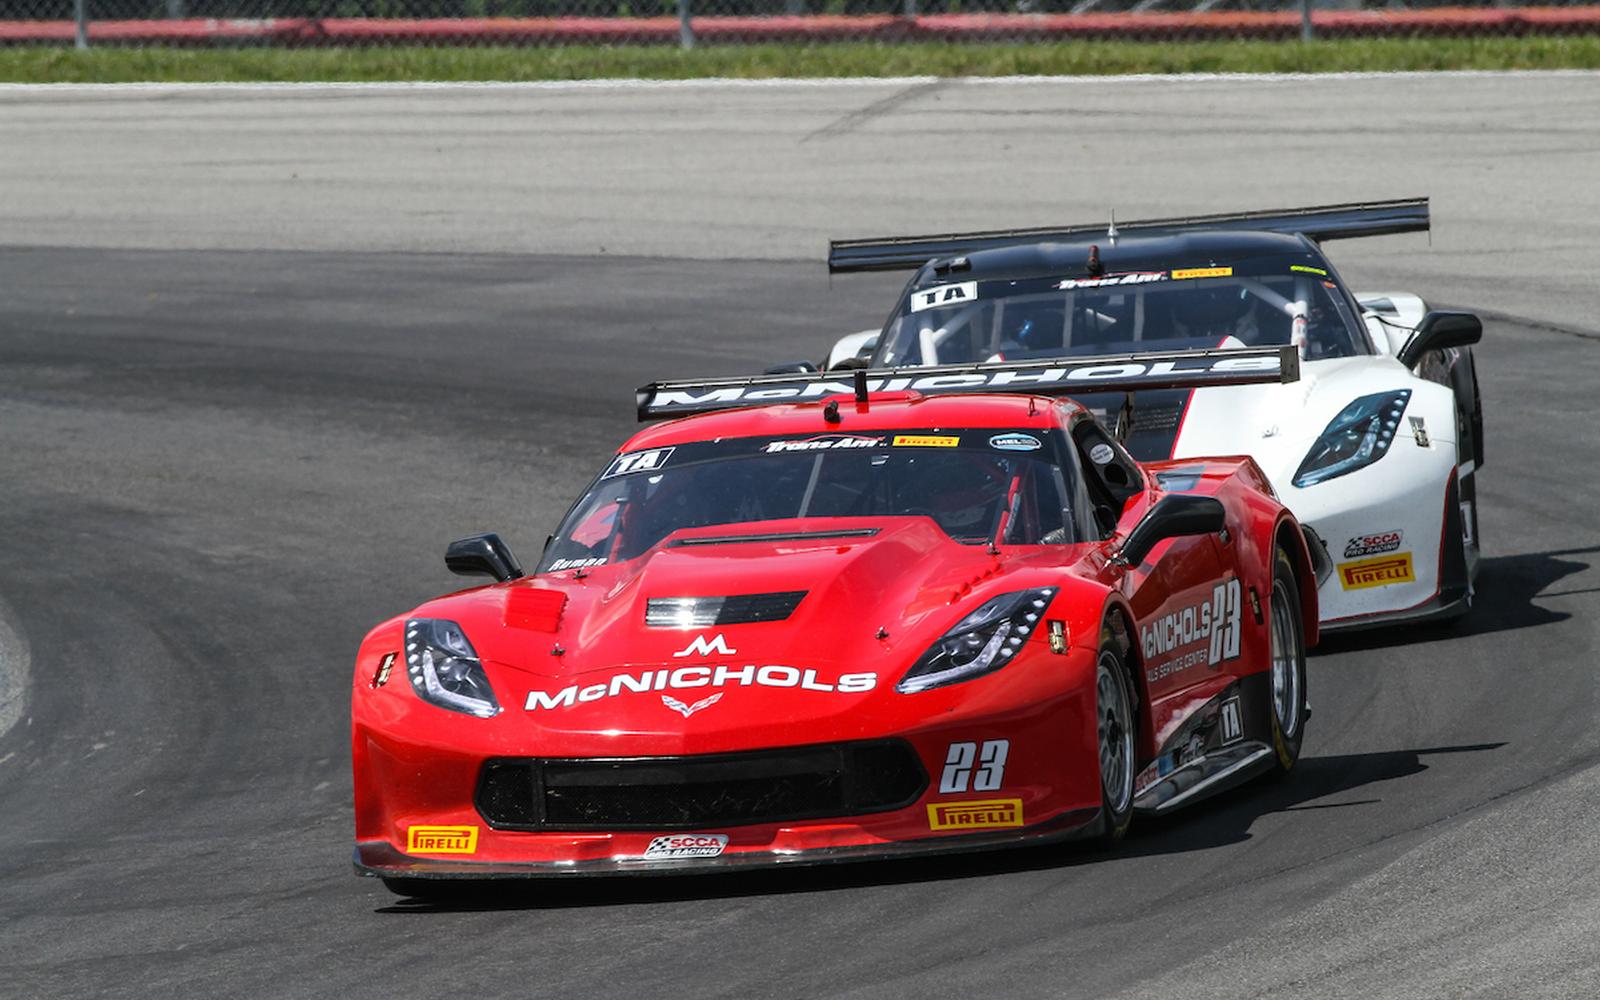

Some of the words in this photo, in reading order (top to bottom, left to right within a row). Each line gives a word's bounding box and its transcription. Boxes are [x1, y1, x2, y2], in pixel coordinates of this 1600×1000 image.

[920, 286, 966, 305] TA
[650, 355, 1282, 407] McNICHOLS
[766, 440, 834, 453] Trans
[614, 451, 661, 474] TA
[1362, 532, 1400, 548] SCCA
[1343, 558, 1409, 586] PIRELLI
[1208, 578, 1241, 666] 23
[523, 664, 878, 712] McNICHOLS
[1221, 701, 1241, 740] TA
[938, 738, 1009, 794] 23
[935, 803, 1015, 826] PIRELLI
[412, 829, 472, 849] PIRELLI
[671, 837, 721, 848] SCCA
[672, 847, 719, 856] RACING
